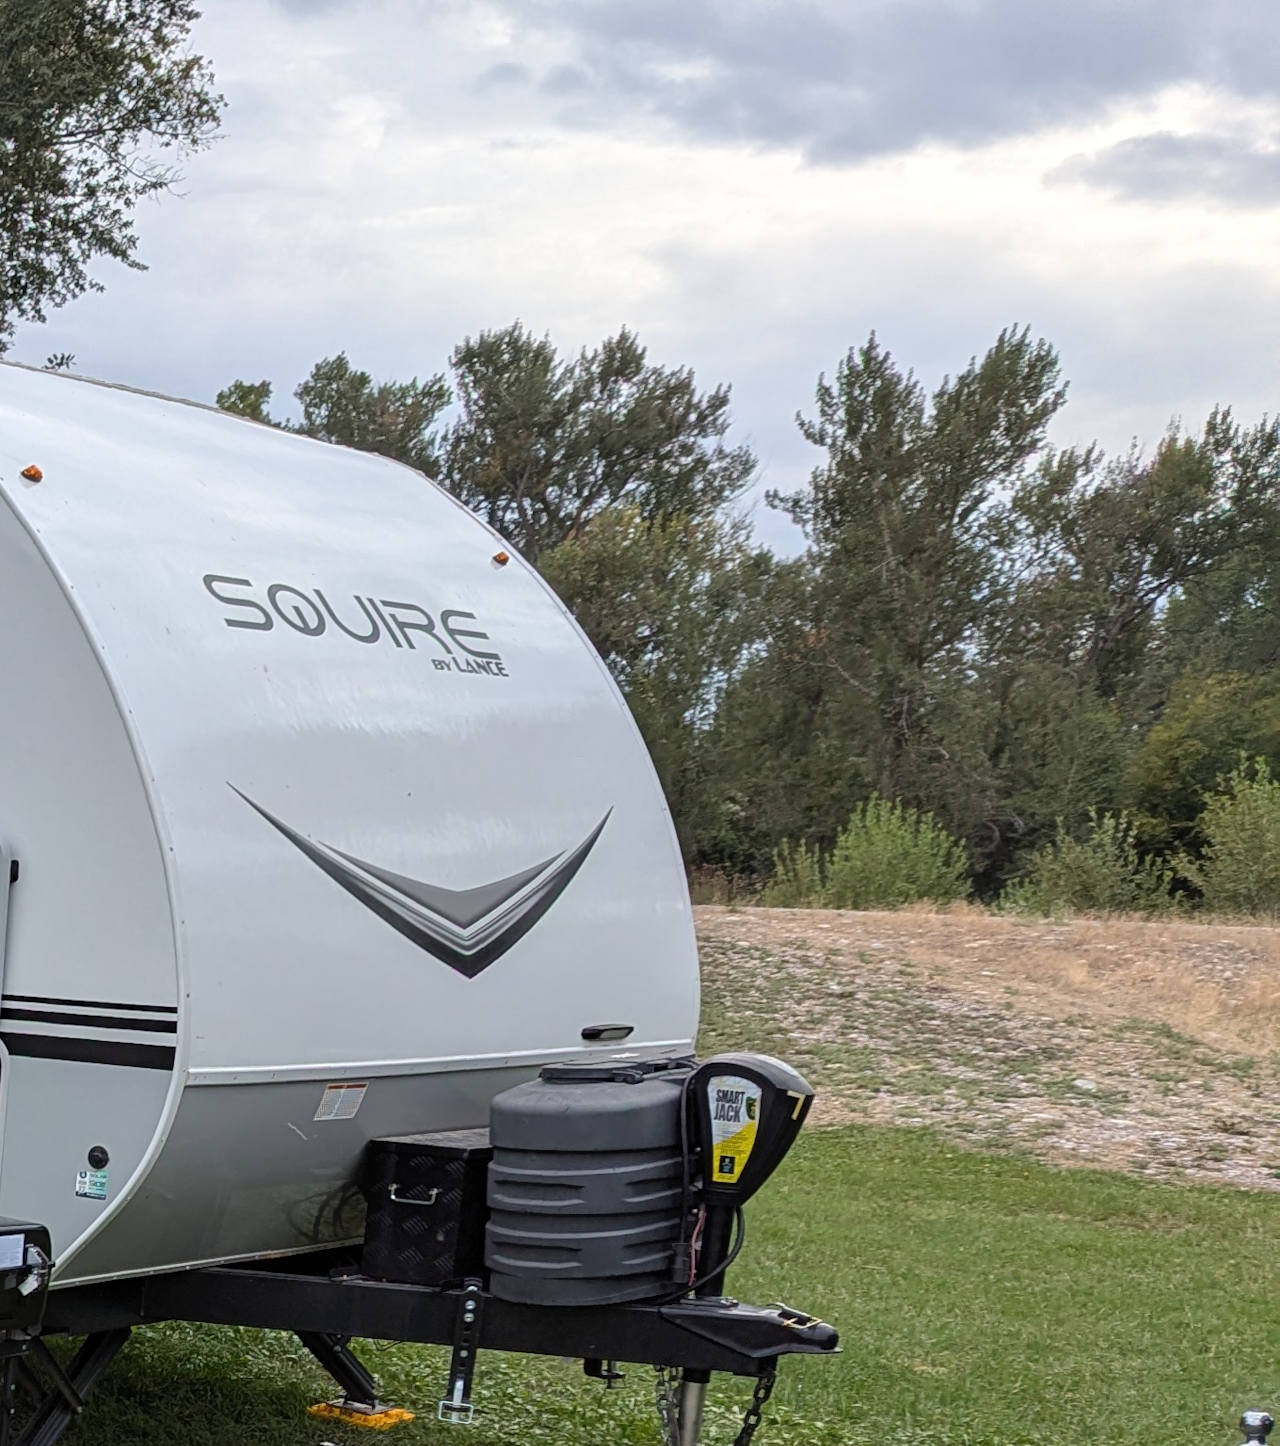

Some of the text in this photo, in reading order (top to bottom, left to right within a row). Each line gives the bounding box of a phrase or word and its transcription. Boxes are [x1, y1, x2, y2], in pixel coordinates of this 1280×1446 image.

[203, 574, 501, 660] SQUIRE
[431, 656, 509, 677] BY LANCE
[716, 1089, 745, 1105] SMART
[714, 1103, 741, 1122] JACK
